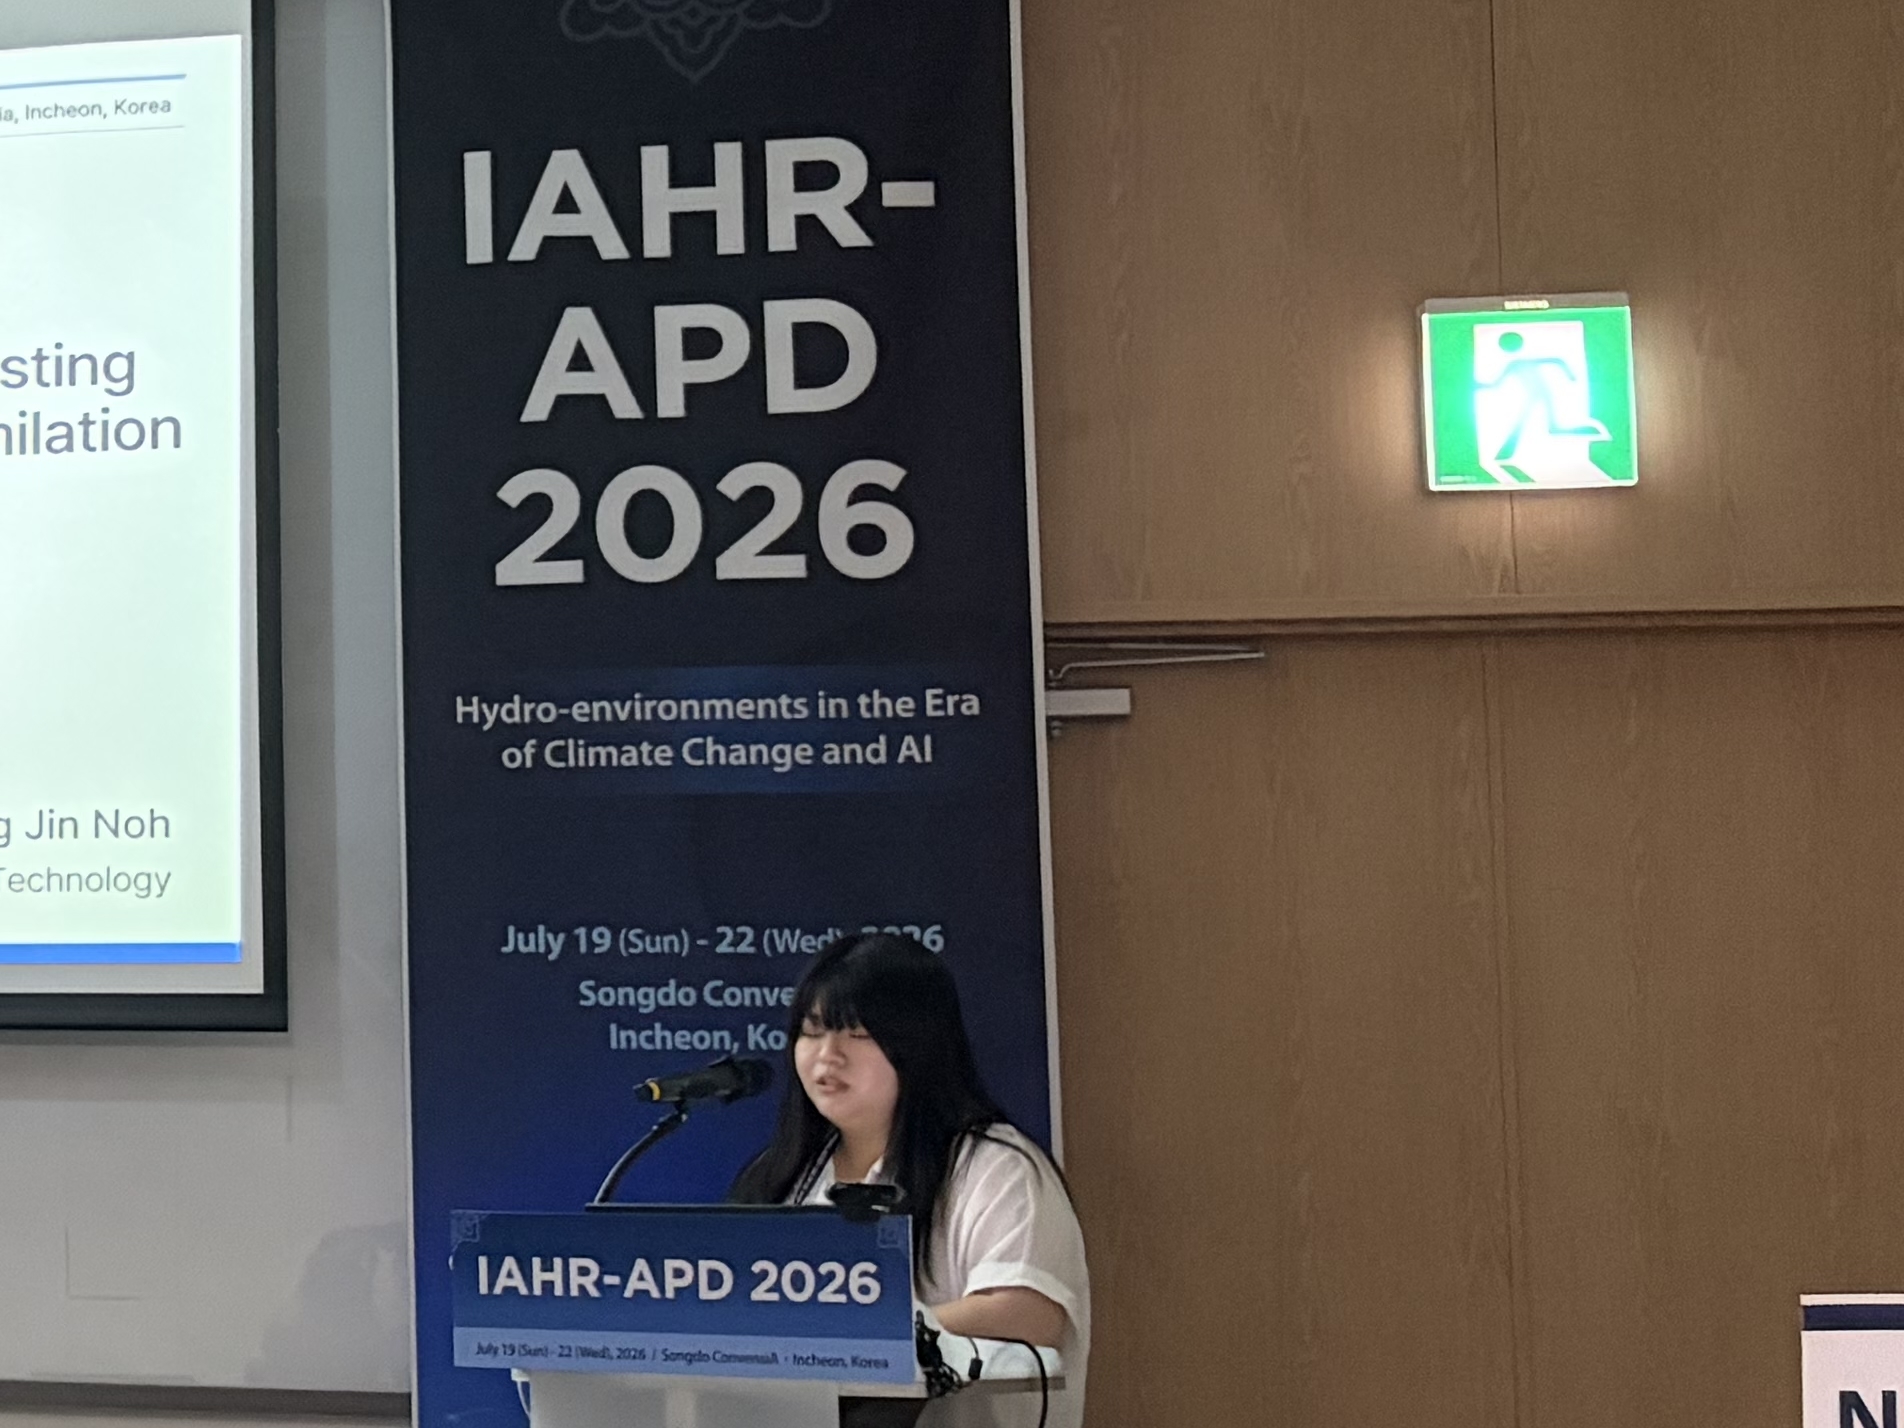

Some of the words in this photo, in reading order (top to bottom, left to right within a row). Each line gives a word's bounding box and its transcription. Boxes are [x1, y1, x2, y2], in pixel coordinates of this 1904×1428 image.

[24, 101, 108, 123] Incheon,
[113, 97, 172, 115] Korea
[463, 136, 936, 265] IAHR-
[519, 297, 878, 423] APD
[495, 459, 915, 586] 2026
[455, 692, 809, 732] Hydro-environments
[818, 691, 849, 720] in
[857, 691, 916, 719] the
[925, 688, 981, 717] Era
[501, 739, 536, 769] of
[544, 739, 674, 768] Climate
[681, 737, 814, 772] Change
[823, 735, 887, 764] and
[897, 735, 933, 764] AI
[24, 809, 79, 840] Jin
[93, 808, 171, 840] Noh
[501, 925, 565, 961] July
[574, 926, 612, 954] 19
[619, 929, 690, 959] (Sun)
[715, 927, 756, 954] 22
[579, 979, 696, 1014] Songdo
[703, 982, 795, 1007] Conve
[610, 1024, 739, 1055] Incheon,
[477, 1255, 734, 1301] IAHR-APD
[750, 1260, 880, 1305] 2026
[476, 1342, 499, 1357] July
[502, 1343, 516, 1356] 19
[557, 1345, 572, 1358] 22
[616, 1347, 646, 1360] 2026
[851, 1355, 889, 1369] Korea
